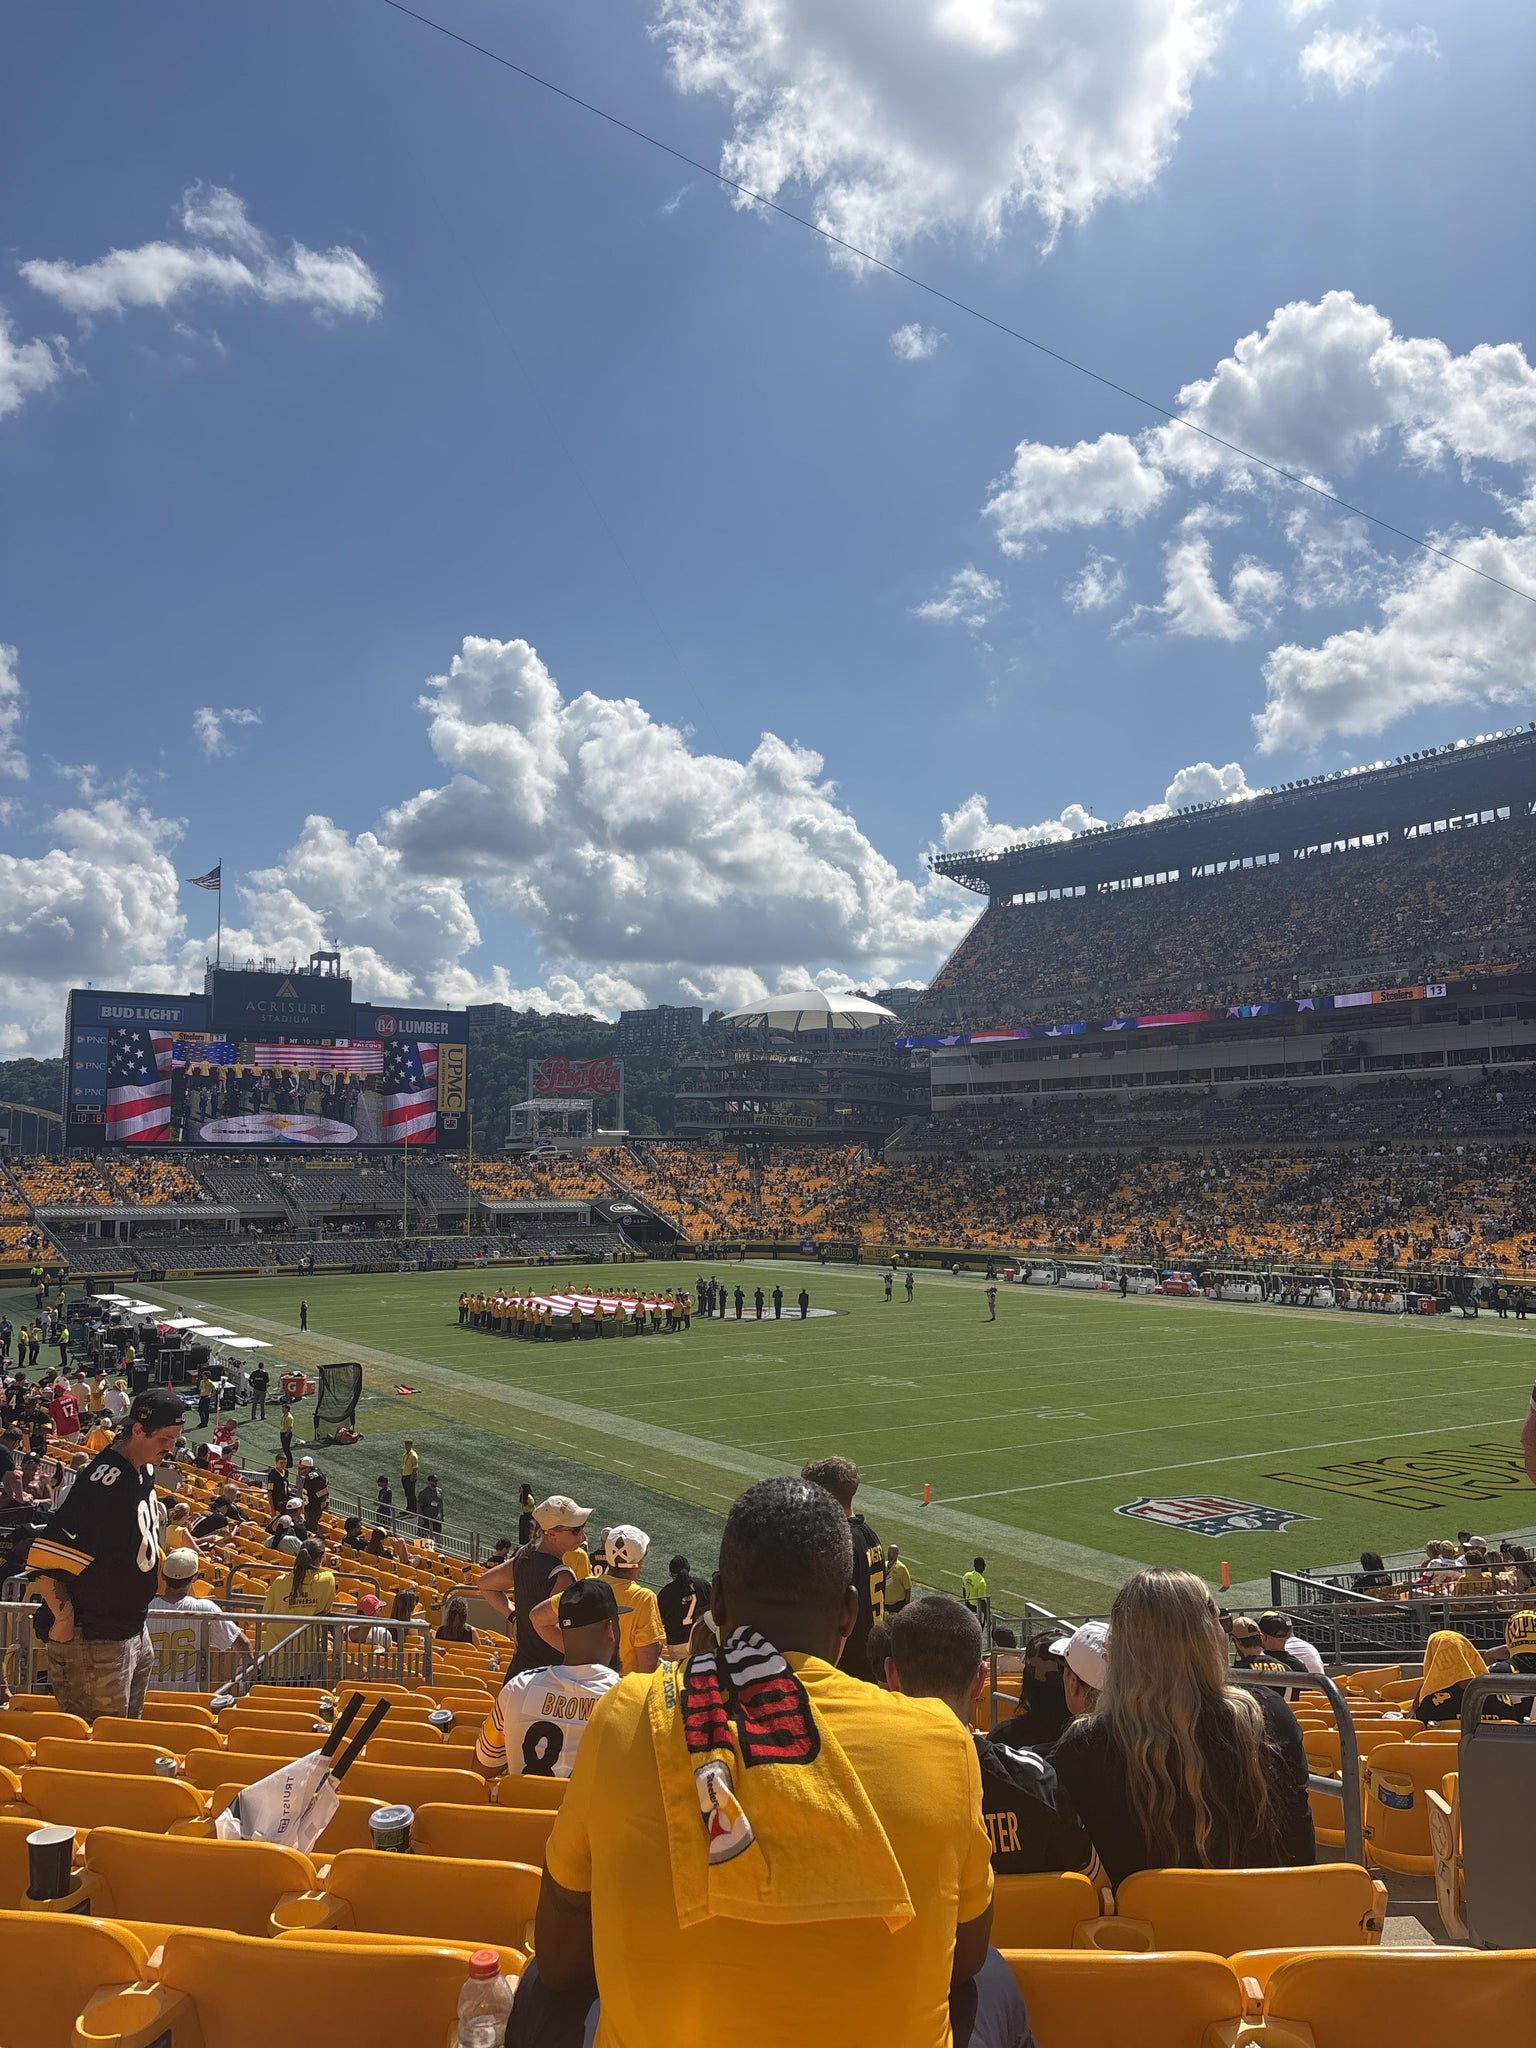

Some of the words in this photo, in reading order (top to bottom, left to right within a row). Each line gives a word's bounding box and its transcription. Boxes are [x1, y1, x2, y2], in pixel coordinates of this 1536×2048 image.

[1380, 989, 1413, 1001] Steelers
[1430, 986, 1442, 995] 13
[101, 1006, 134, 1018] BUD
[136, 1007, 180, 1021] LIGHT
[246, 1001, 327, 1014] ACRISURE
[261, 1014, 310, 1024] STADIUM
[377, 1019, 394, 1033] 84
[398, 1020, 449, 1035] LUMBER
[86, 1037, 107, 1045] PNC
[85, 1062, 106, 1070] PNC
[446, 1047, 464, 1108] UPMC
[84, 1089, 105, 1097] PNC
[755, 1115, 813, 1128] #HEREWEGO
[823, 1245, 853, 1258] Steelers
[354, 1263, 395, 1272] PITTSBURGH
[287, 1381, 297, 1392] G
[8, 1394, 17, 1410] 4
[61, 1404, 74, 1418] 17
[90, 1463, 121, 1486] 88
[1129, 1498, 1256, 1522] NFL
[541, 1692, 601, 1721] BROW
[705, 1772, 720, 1809] Steelers
[984, 1811, 1022, 1854] TER
